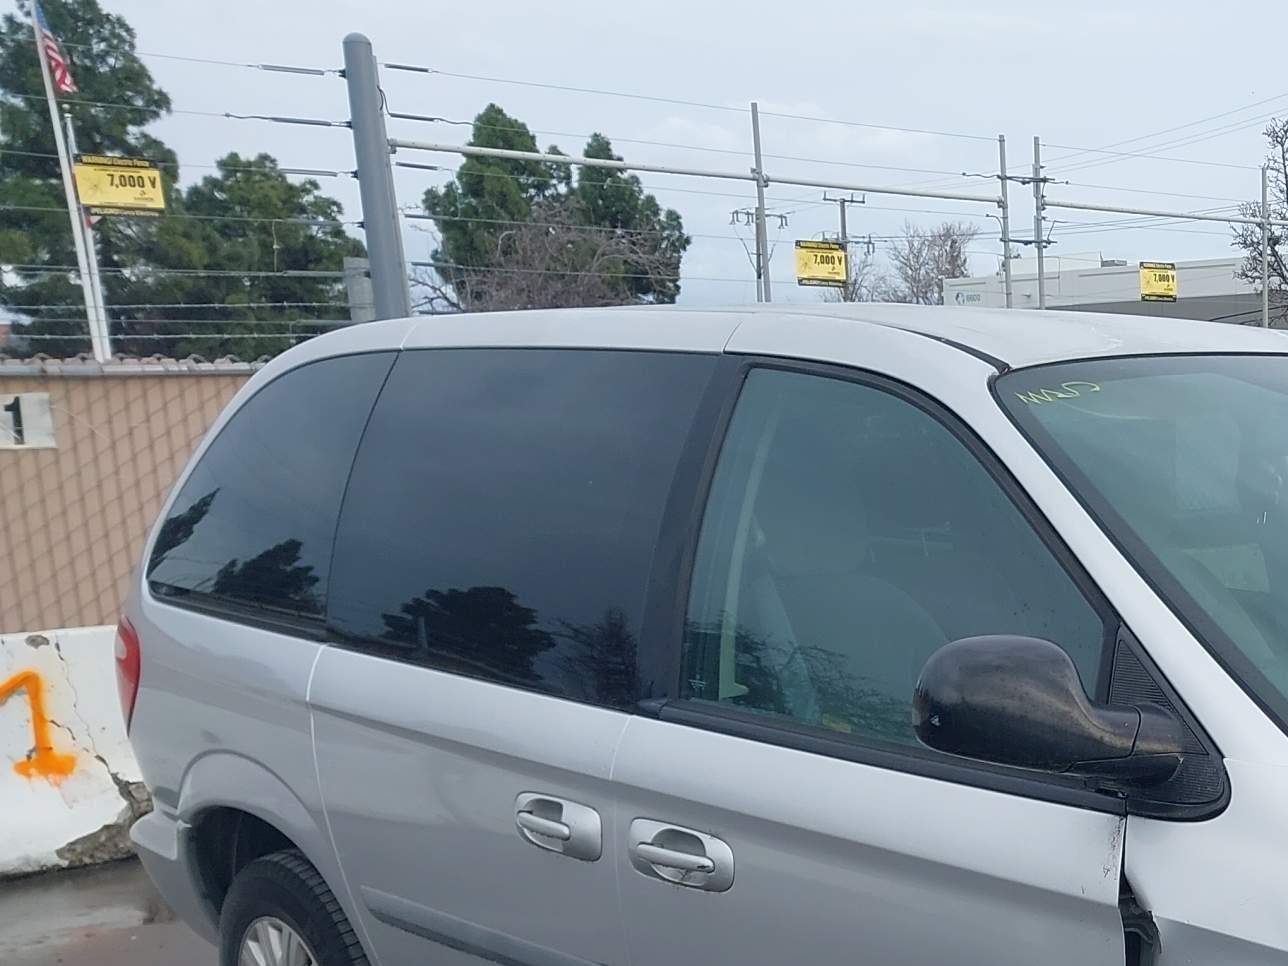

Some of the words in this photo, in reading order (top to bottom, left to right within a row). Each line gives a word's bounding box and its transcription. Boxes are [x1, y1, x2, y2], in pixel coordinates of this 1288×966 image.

[106, 173, 145, 189] 7,000
[147, 175, 157, 189] V
[813, 254, 836, 265] 7,000
[837, 255, 843, 266] V
[1153, 273, 1170, 283] 7,000
